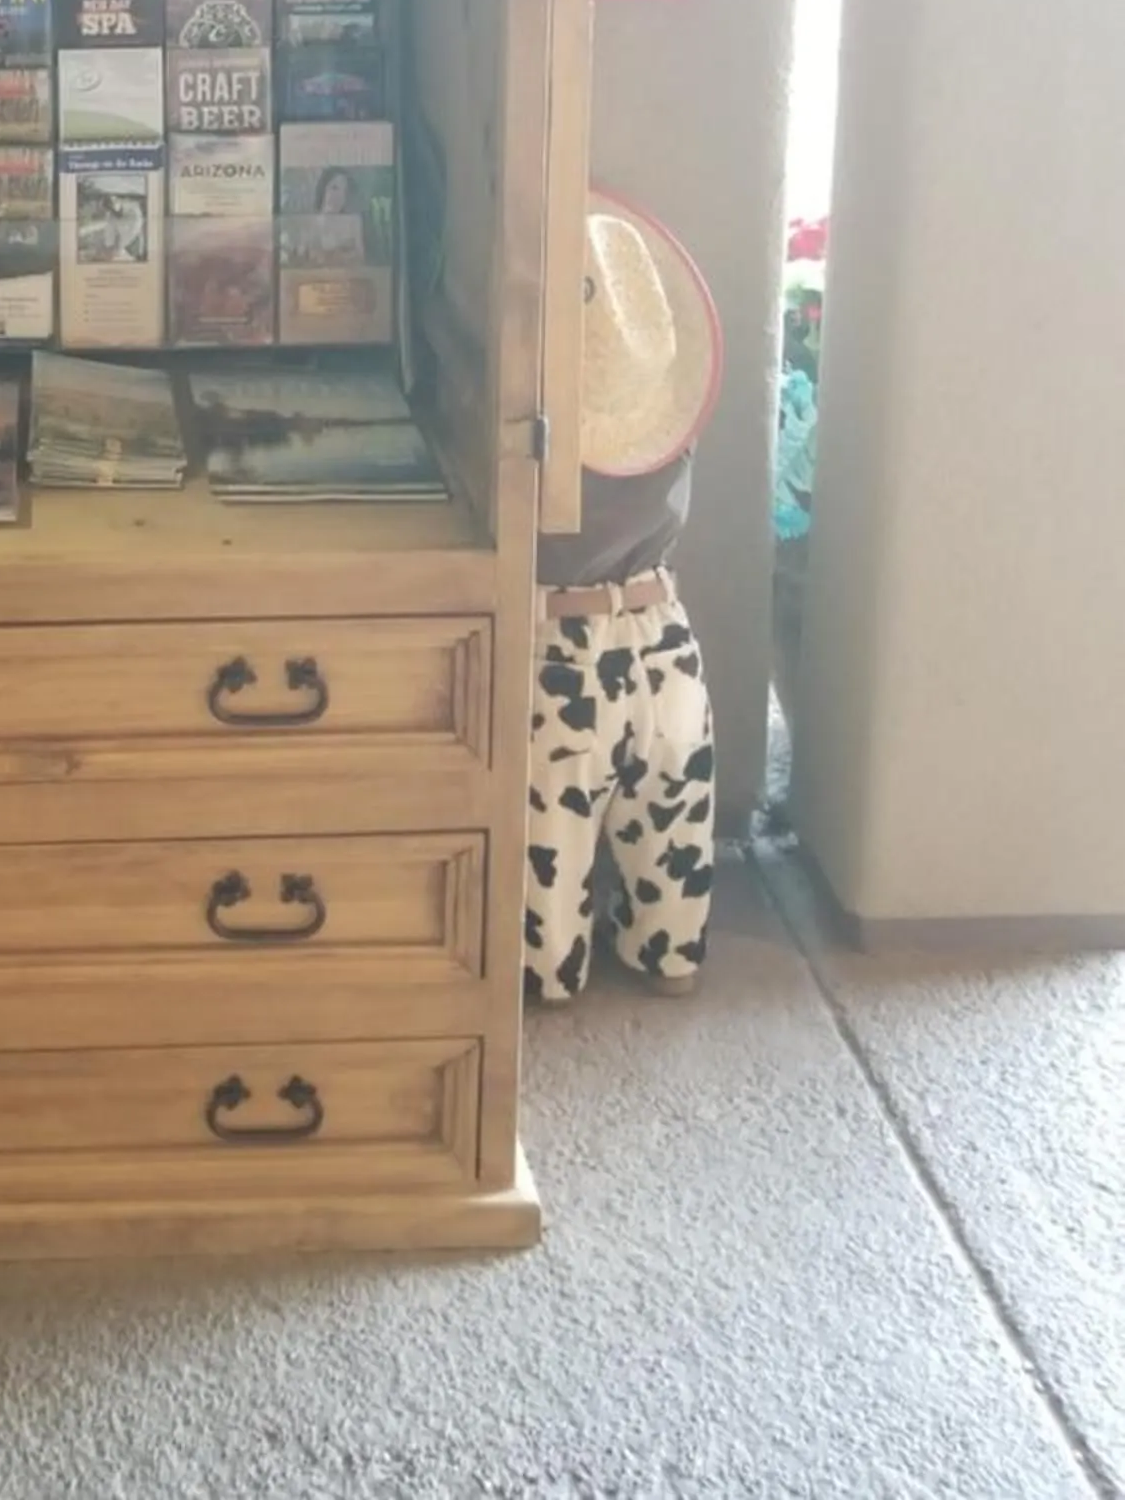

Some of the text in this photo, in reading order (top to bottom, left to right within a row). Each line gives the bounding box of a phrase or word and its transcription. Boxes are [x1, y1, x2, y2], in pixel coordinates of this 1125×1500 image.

[81, 12, 138, 36] SPA
[178, 71, 261, 102] CRAFT
[179, 105, 262, 131] BEER
[180, 163, 266, 179] ARIZONA
